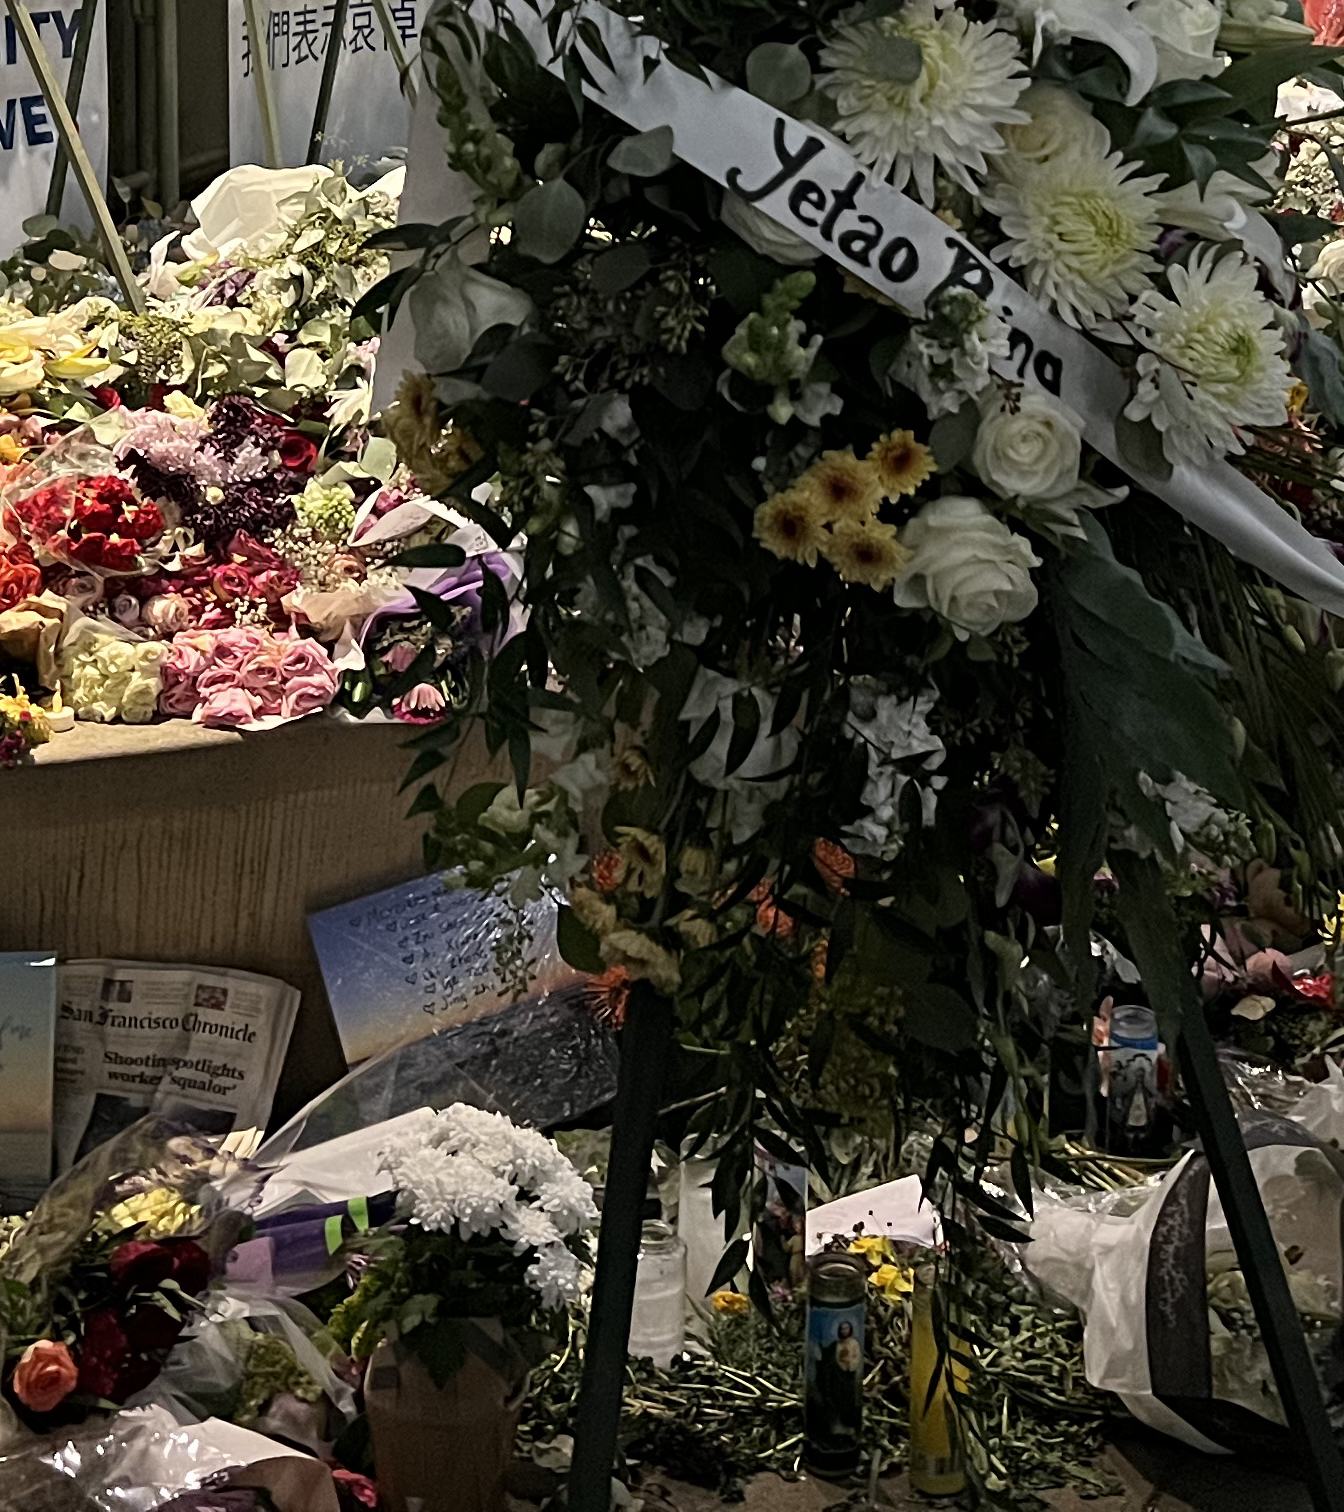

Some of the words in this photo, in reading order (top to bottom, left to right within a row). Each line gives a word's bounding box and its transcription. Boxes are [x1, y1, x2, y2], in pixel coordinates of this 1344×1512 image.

[726, 117, 919, 283] Yetao
[57, 1000, 93, 1023] San
[96, 1005, 179, 1030] Francisco
[181, 1012, 256, 1044] Chronicle
[102, 1051, 168, 1068] Shootin
